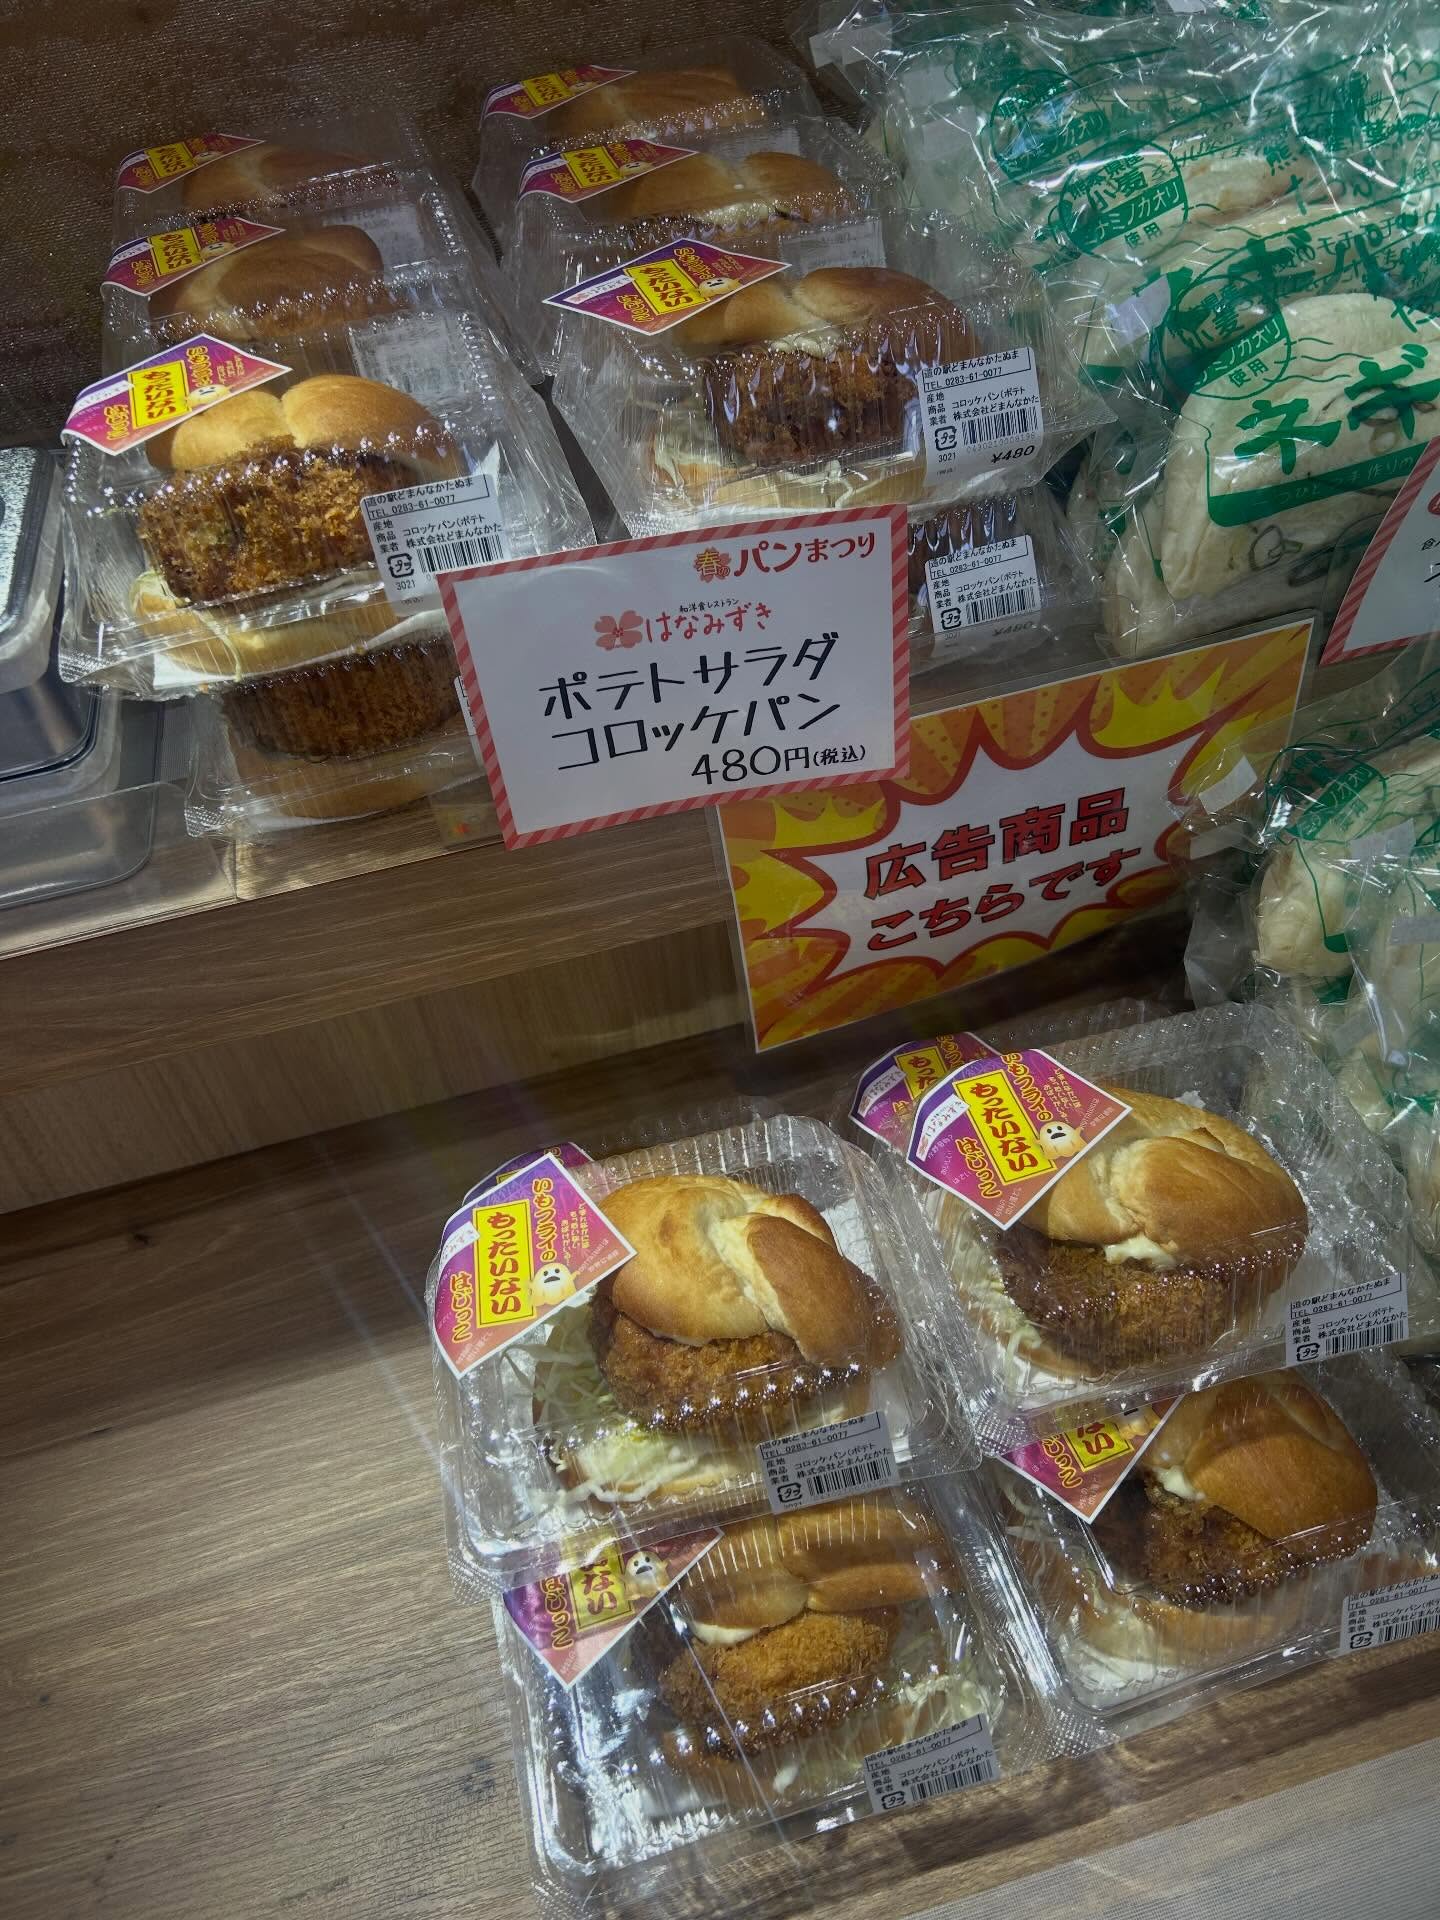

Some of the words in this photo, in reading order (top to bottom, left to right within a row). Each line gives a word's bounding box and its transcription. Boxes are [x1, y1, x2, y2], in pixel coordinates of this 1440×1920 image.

[1089, 169, 1148, 211] 小麦
[1124, 222, 1162, 249] 使用
[638, 267, 695, 308] もったいない
[924, 351, 1019, 378] 道の駅どまんなかたぬま
[926, 382, 942, 390] TEL
[945, 367, 1002, 386] 0283-61-0077
[143, 370, 177, 419] もったいない
[926, 392, 944, 403] 産地
[928, 404, 945, 415] 商品
[930, 415, 947, 426] 業者
[953, 395, 1039, 421] 株式会社どまんなかた
[938, 453, 956, 463] 3021
[991, 445, 1036, 464] ¥480
[367, 478, 474, 507] 道の駅どまんなかたぬま
[370, 510, 387, 519] TEL
[392, 495, 455, 514] 0283-61-0077
[373, 520, 393, 532] 産地
[376, 531, 397, 543] 商品
[379, 542, 400, 554] 業者
[406, 523, 503, 548] 株式会社どまんなかた
[930, 539, 1017, 568] 道の駅どまんなかたぬま
[931, 570, 947, 578] TEL
[950, 555, 1002, 574] 0283-61-0077
[396, 579, 416, 591] 3021
[933, 579, 949, 589] 産地
[934, 589, 951, 599] 商品
[679, 597, 740, 614] 和洋食レストラン
[936, 599, 952, 608] 業者
[645, 602, 772, 643] はなみずき
[538, 631, 840, 720] ポテトサラダ
[551, 692, 841, 770] コロッケパン
[690, 744, 866, 785] 480円(税込)
[864, 786, 1129, 901] 広告商品
[867, 847, 1142, 952] こちらです
[1001, 1053, 1053, 1122] いもフライの
[969, 1082, 1039, 1172] もったいない
[956, 1137, 1001, 1199] はじっこ
[532, 1177, 558, 1263] いもフライの
[487, 1211, 521, 1315] もったいない
[450, 1270, 474, 1344] はじっこ
